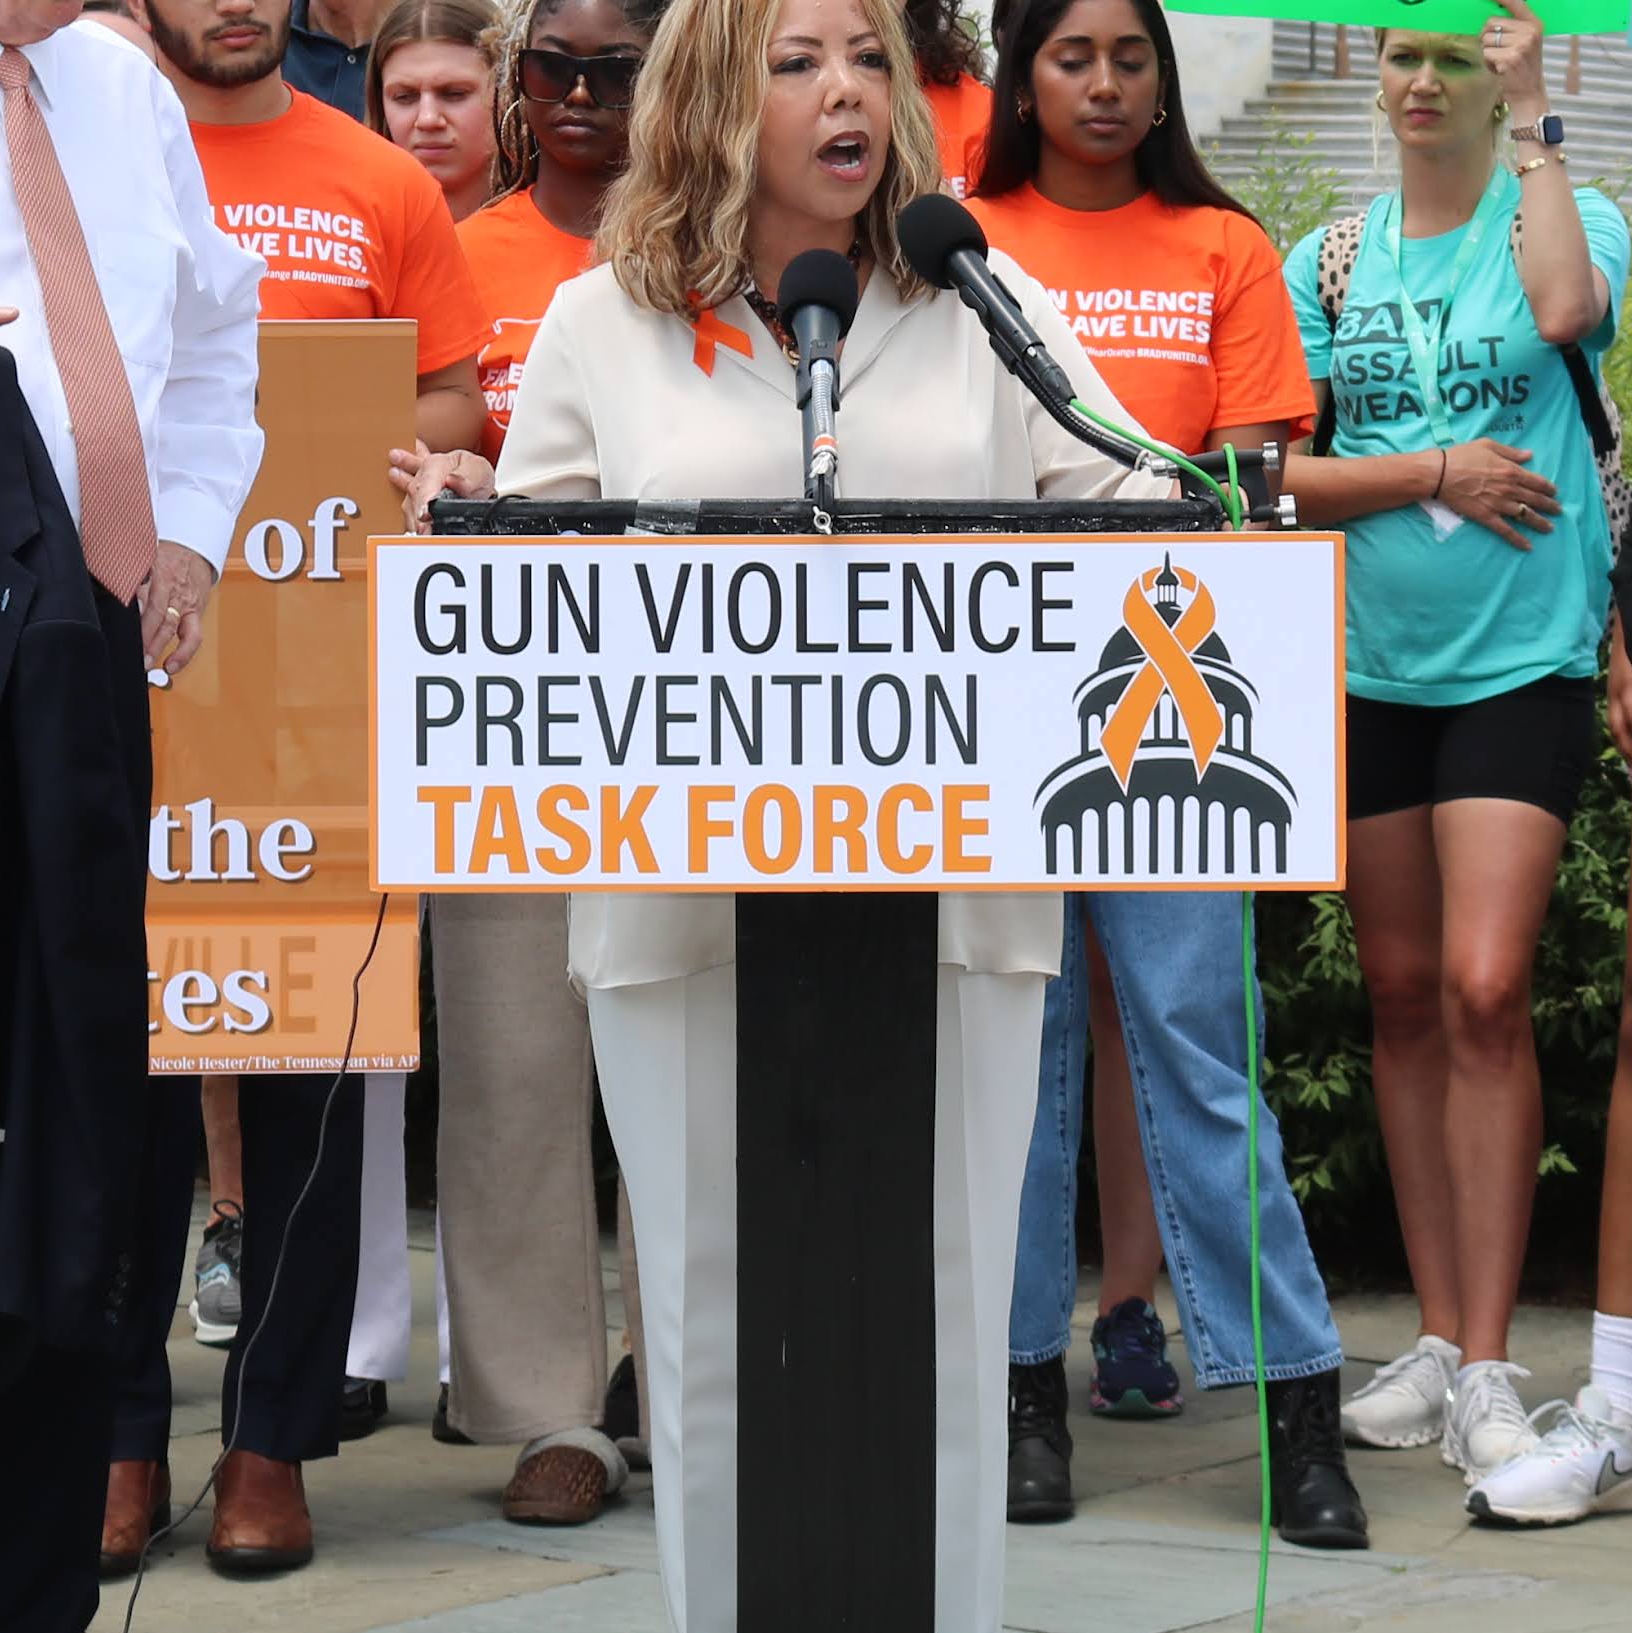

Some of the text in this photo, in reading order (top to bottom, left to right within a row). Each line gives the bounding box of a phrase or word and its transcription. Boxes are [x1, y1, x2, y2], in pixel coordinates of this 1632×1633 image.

[224, 203, 371, 246] VIOLENCE.
[229, 232, 368, 273] AVE LIVES.
[1074, 288, 1215, 317] VIOLENCE
[1133, 315, 1211, 344] LIVES
[1336, 374, 1532, 426] WEAONS
[244, 496, 358, 581] of
[414, 560, 1077, 655] GUN VIOLENCE
[415, 673, 979, 767] PREVENTION
[148, 797, 315, 881] the
[417, 781, 992, 875] TASK FORCE
[150, 1056, 195, 1071] Nicole
[197, 1055, 280, 1071] Hester/The
[371, 1054, 394, 1068] via
[397, 1054, 419, 1068] AP
